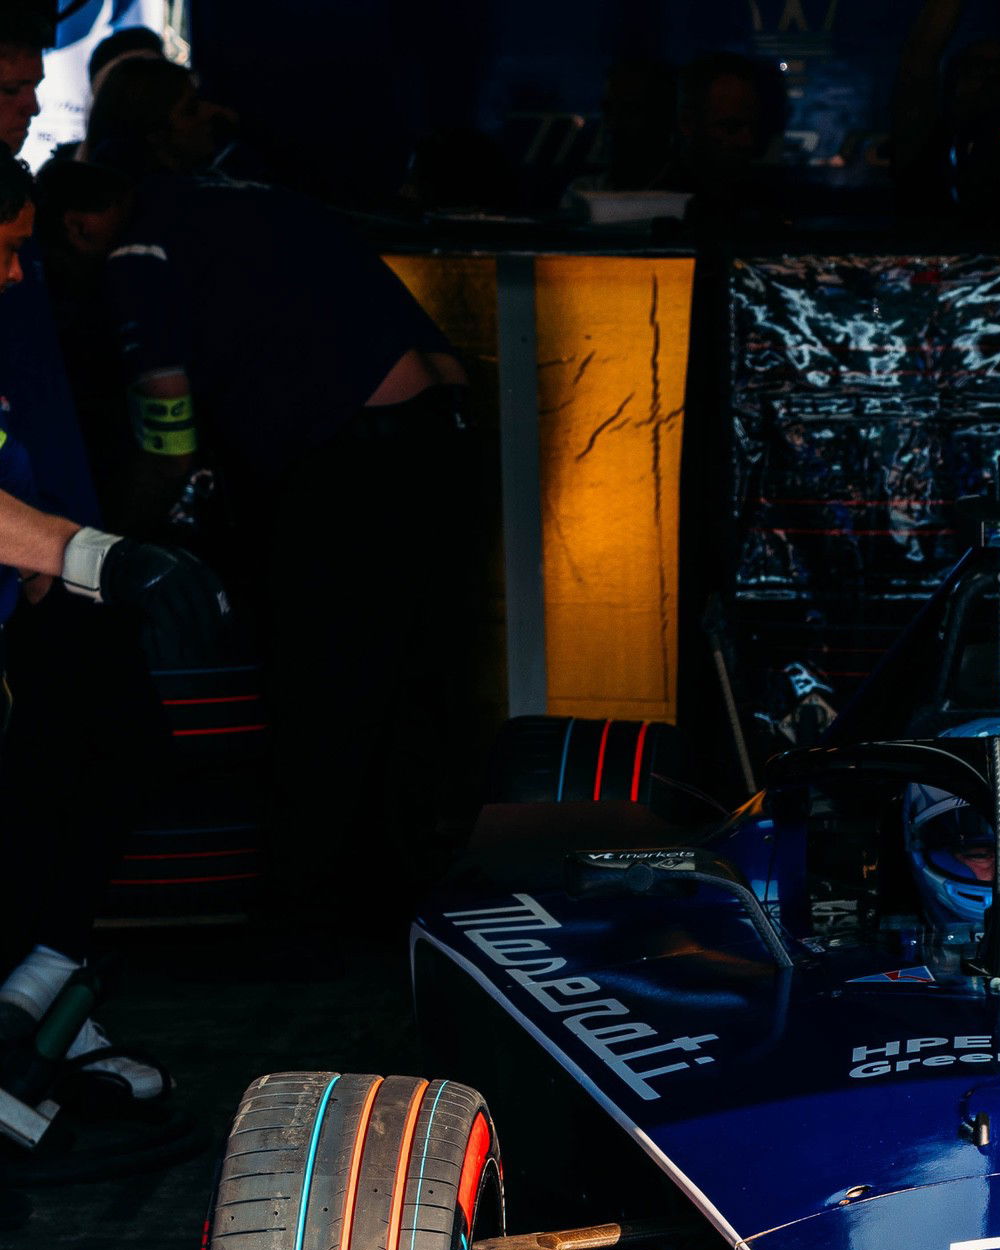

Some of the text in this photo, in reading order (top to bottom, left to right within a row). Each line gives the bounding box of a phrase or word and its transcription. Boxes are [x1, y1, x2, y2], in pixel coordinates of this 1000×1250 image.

[619, 851, 695, 859] markets
[442, 893, 719, 1101] Maserati
[852, 1035, 993, 1063] HPE
